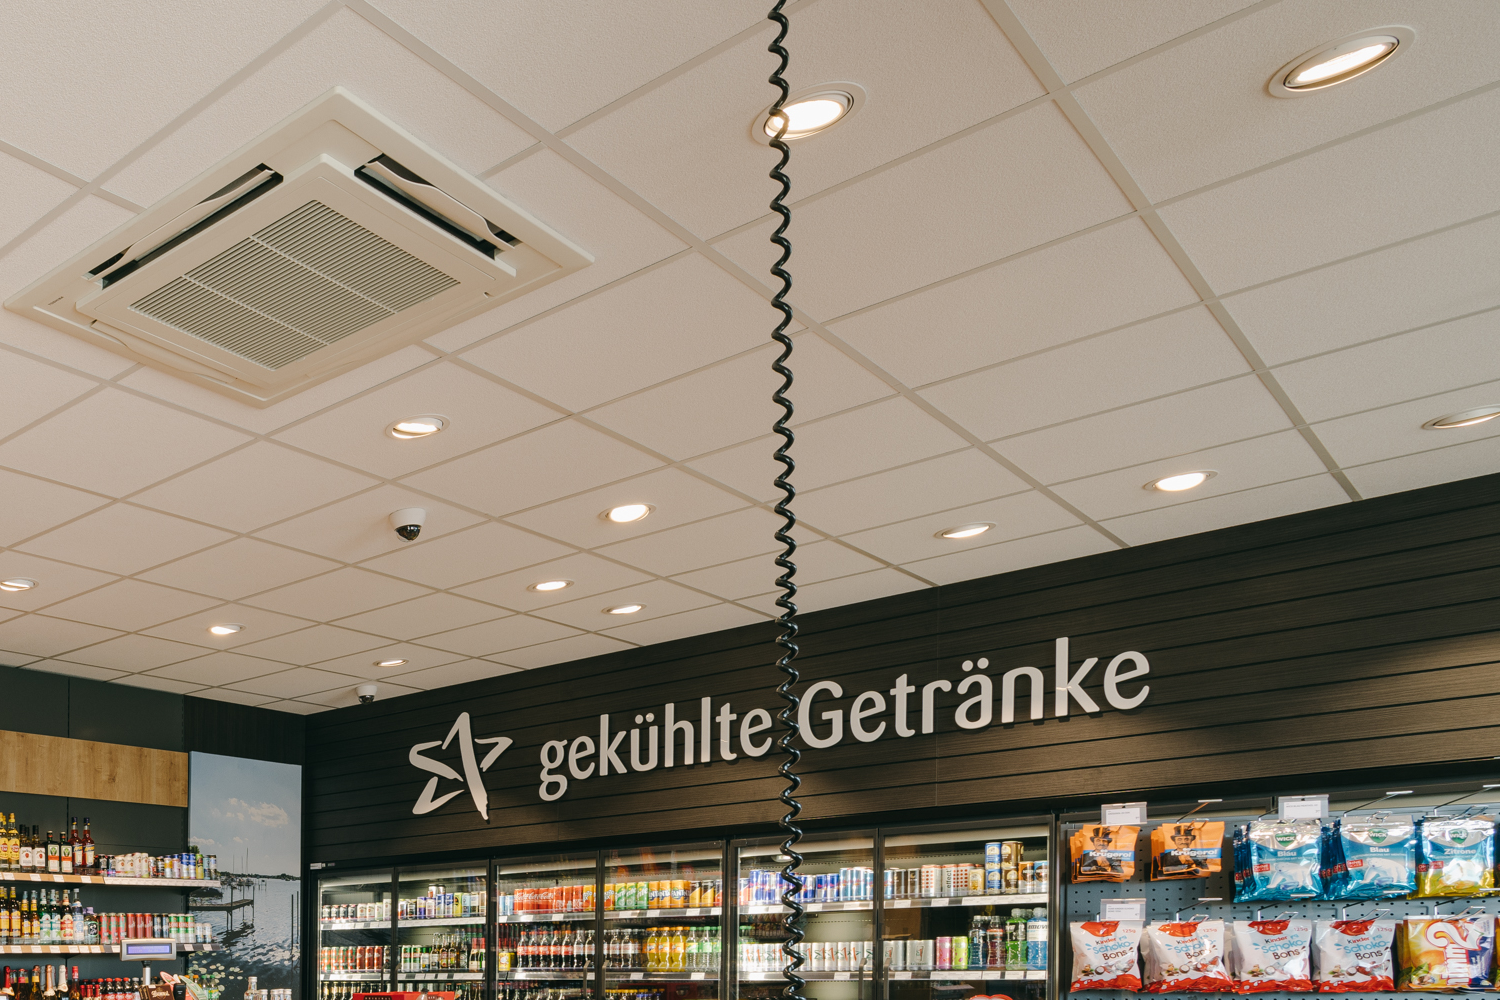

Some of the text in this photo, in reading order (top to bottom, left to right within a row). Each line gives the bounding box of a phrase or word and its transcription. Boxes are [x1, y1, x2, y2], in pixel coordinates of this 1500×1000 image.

[538, 636, 1152, 802] gekühlte Getränke
[1102, 950, 1127, 961] Bons
[1273, 949, 1300, 960] Bons
[1355, 949, 1383, 960] Bons
